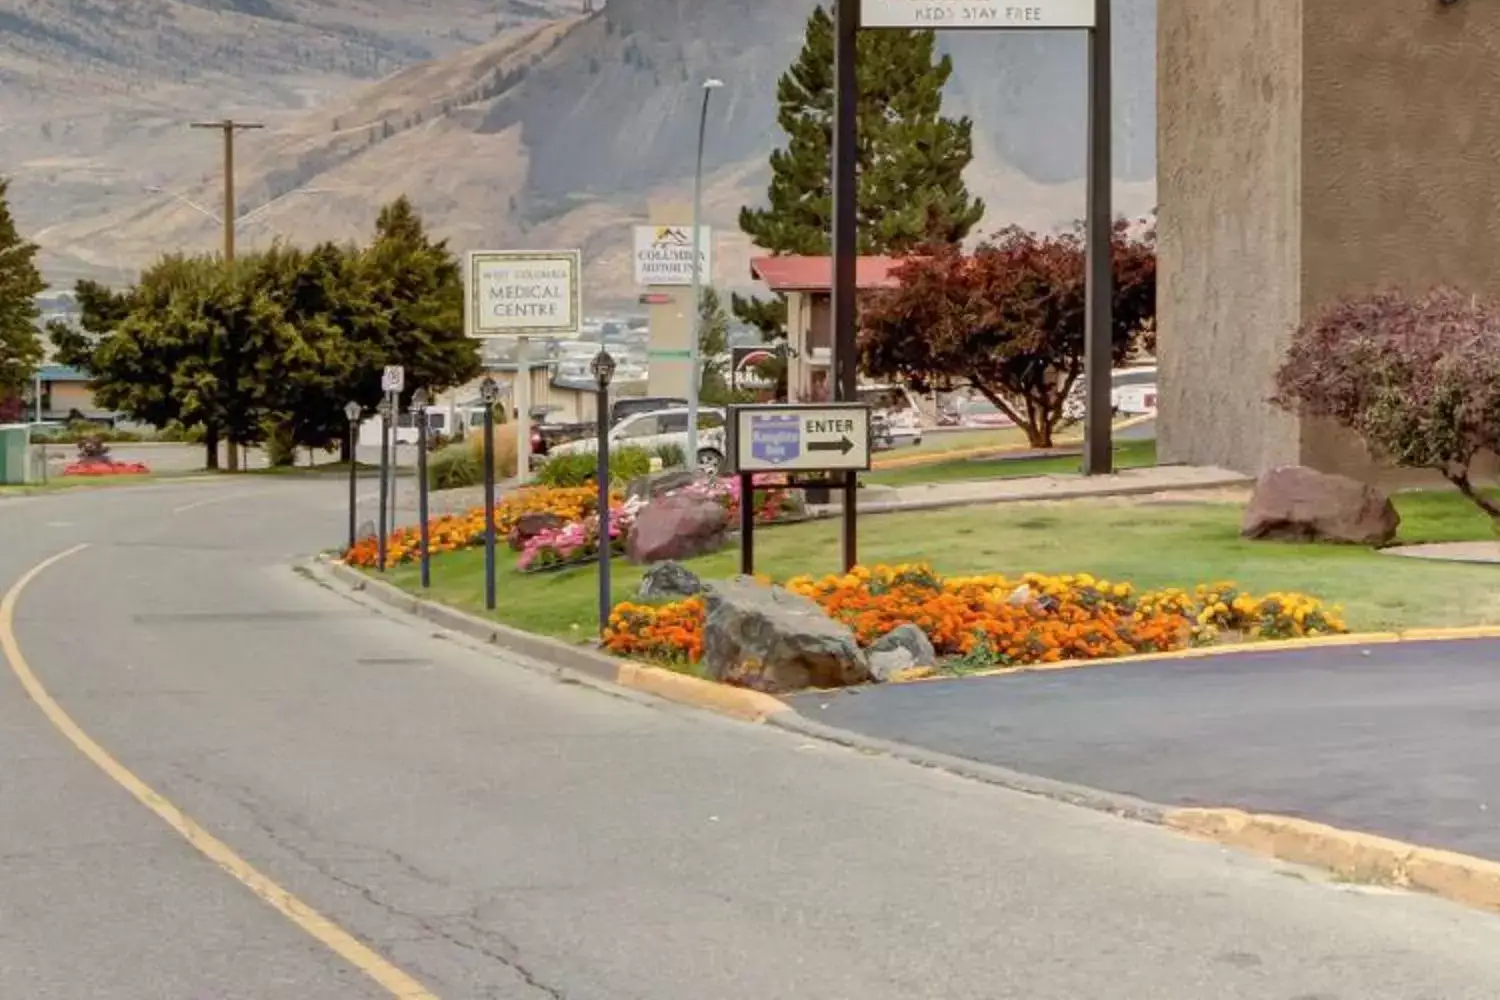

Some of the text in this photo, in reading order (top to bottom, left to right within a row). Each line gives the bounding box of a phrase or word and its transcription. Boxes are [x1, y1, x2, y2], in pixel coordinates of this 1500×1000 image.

[961, 7, 998, 20] STAY
[1006, 7, 1041, 21] FREE
[638, 249, 705, 261] COLUMBA
[489, 285, 563, 299] MEDICAL
[493, 303, 558, 316] CENTRE
[806, 420, 853, 433] ENTER
